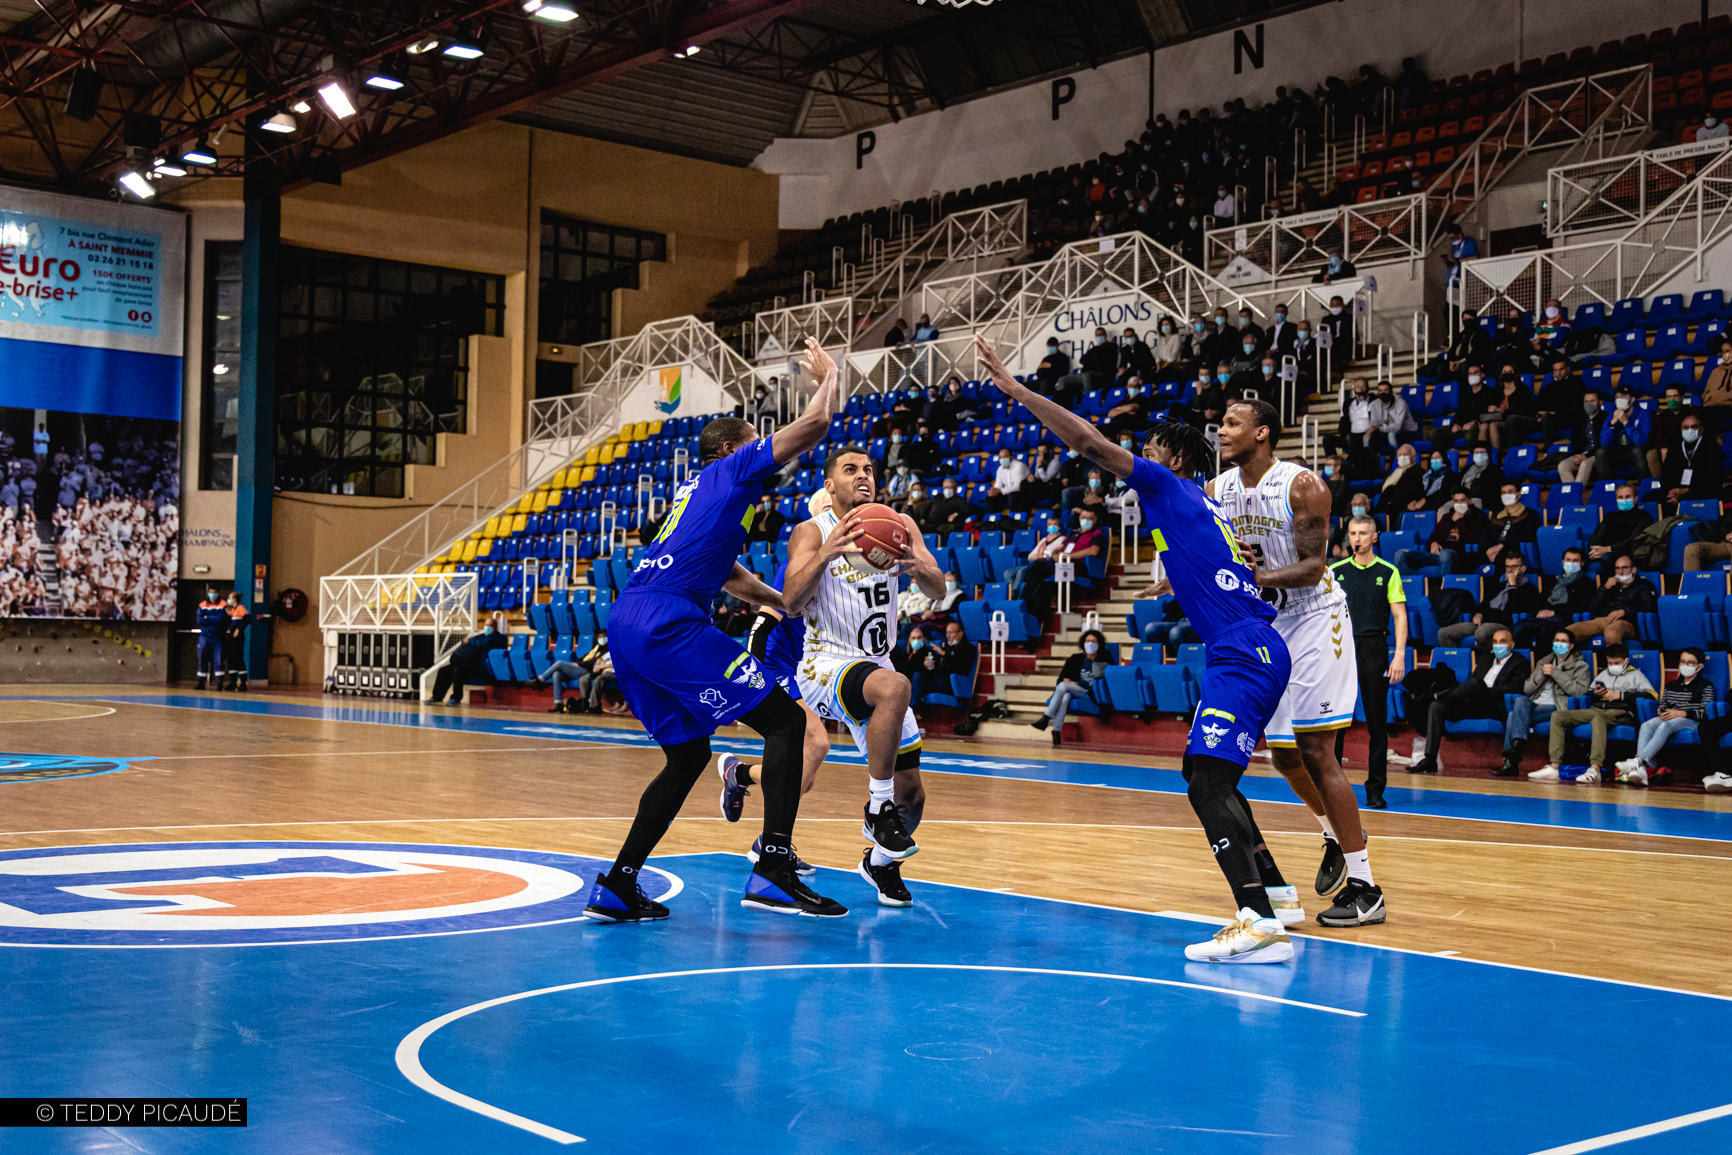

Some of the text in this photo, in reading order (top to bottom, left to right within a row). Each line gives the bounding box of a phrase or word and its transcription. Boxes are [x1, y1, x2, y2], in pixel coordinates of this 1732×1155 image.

[1233, 24, 1264, 75] N
[1051, 77, 1076, 121] P
[856, 131, 876, 169] P
[1656, 151, 1673, 159] TABLE
[1683, 146, 1706, 154] PRESSE
[1707, 142, 1726, 150] RADIO
[67, 228, 80, 237] bis
[82, 231, 95, 239] rue
[134, 238, 155, 247] Ader
[78, 241, 108, 253] SAINT
[111, 245, 154, 259] MEMMIE
[87, 254, 99, 263] 03
[102, 256, 113, 264] 26
[116, 258, 126, 266] 21
[129, 260, 140, 268] 15
[93, 269, 114, 279] 150€
[1054, 300, 1152, 333] CHÂLONS
[1231, 514, 1285, 530] AMPAGNE
[1256, 647, 1272, 664] 11
